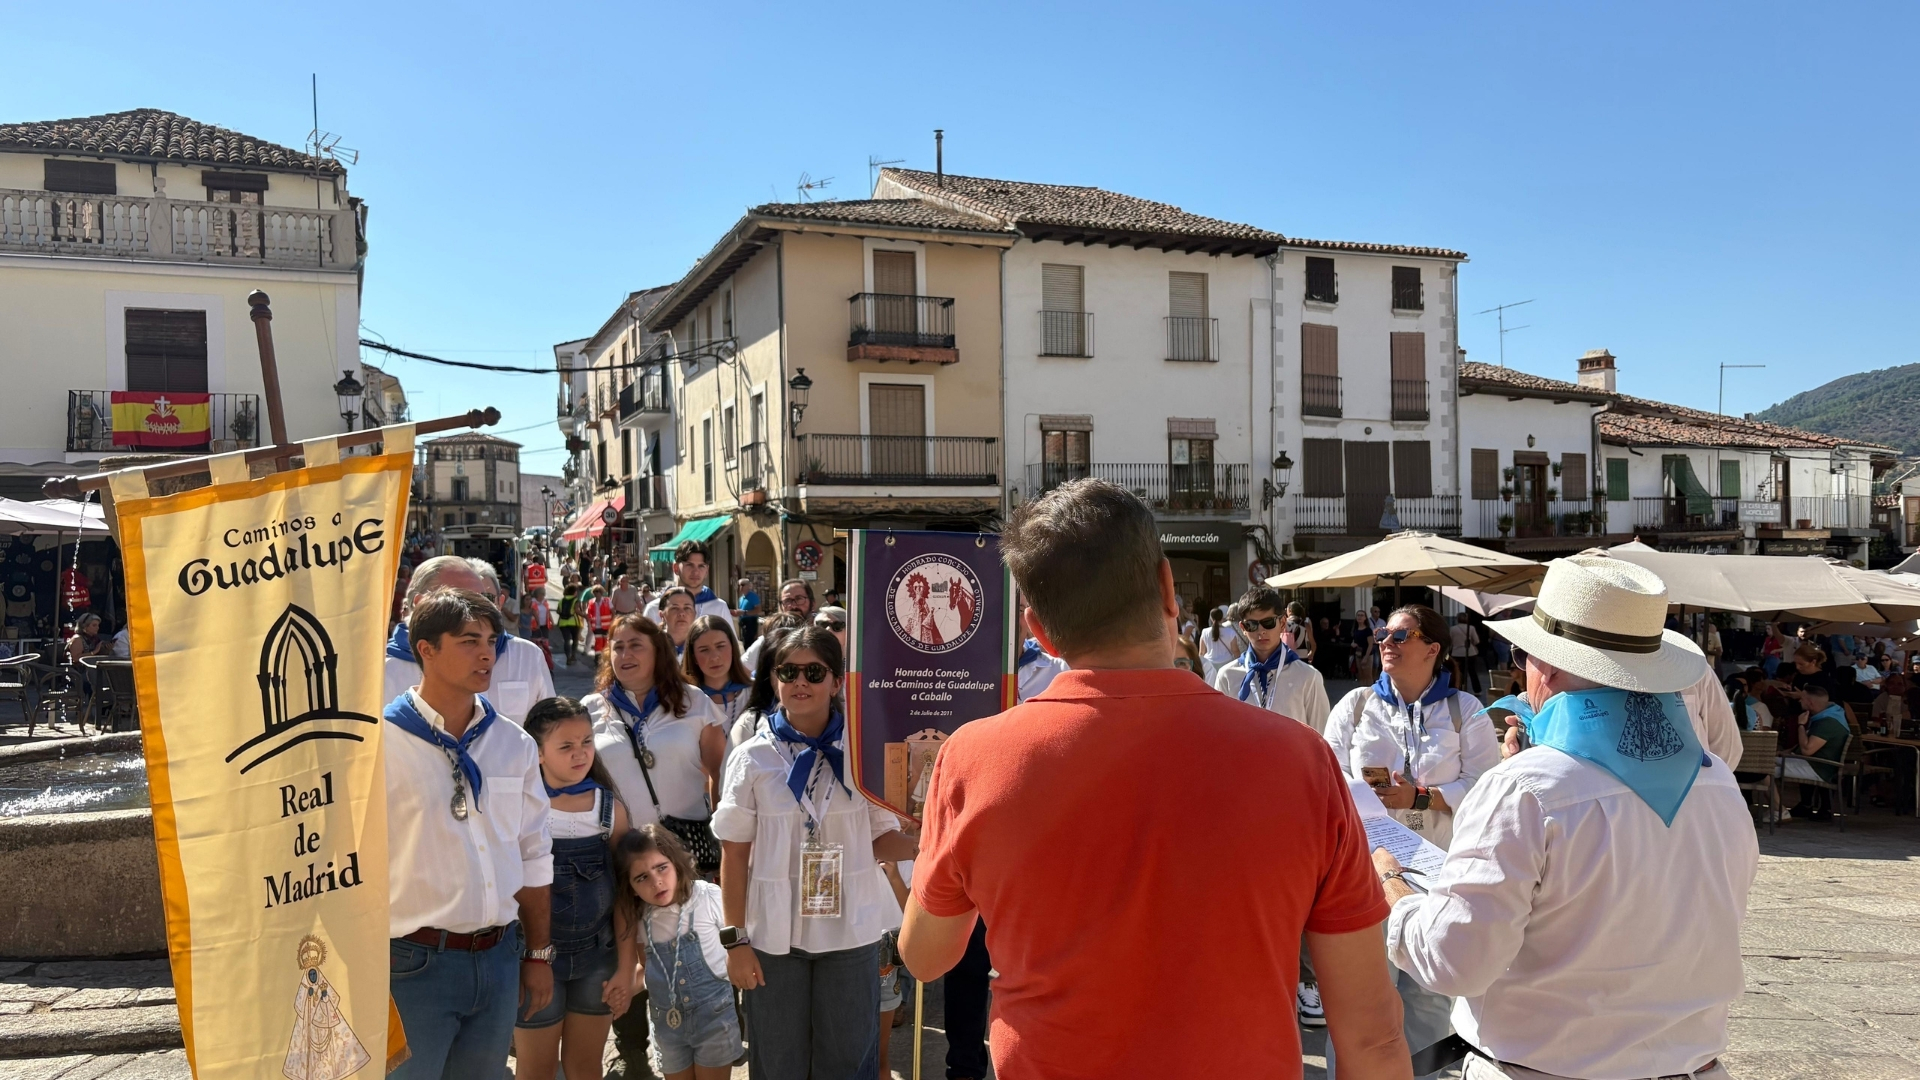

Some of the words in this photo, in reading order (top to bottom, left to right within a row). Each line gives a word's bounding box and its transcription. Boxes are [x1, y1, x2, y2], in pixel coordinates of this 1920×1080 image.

[605, 511, 616, 519] 30
[223, 515, 316, 548] Caminos
[331, 512, 342, 526] a
[1160, 533, 1219, 543] Alimentación
[901, 556, 937, 575] HONRADO
[937, 556, 969, 576] CONCEJO
[918, 642, 930, 651] DE
[931, 629, 972, 652] GUADALUPE
[895, 668, 934, 677] Honrado
[935, 668, 970, 680] Concejo
[868, 679, 880, 689] de
[881, 679, 894, 689] los
[895, 680, 933, 689] Caminos
[935, 680, 946, 689] de
[947, 680, 995, 692] Guadalupe
[911, 693, 917, 701] a
[918, 692, 953, 701] Caballo
[279, 772, 335, 818] Real
[294, 824, 321, 857] de
[264, 852, 363, 908] Madrid
